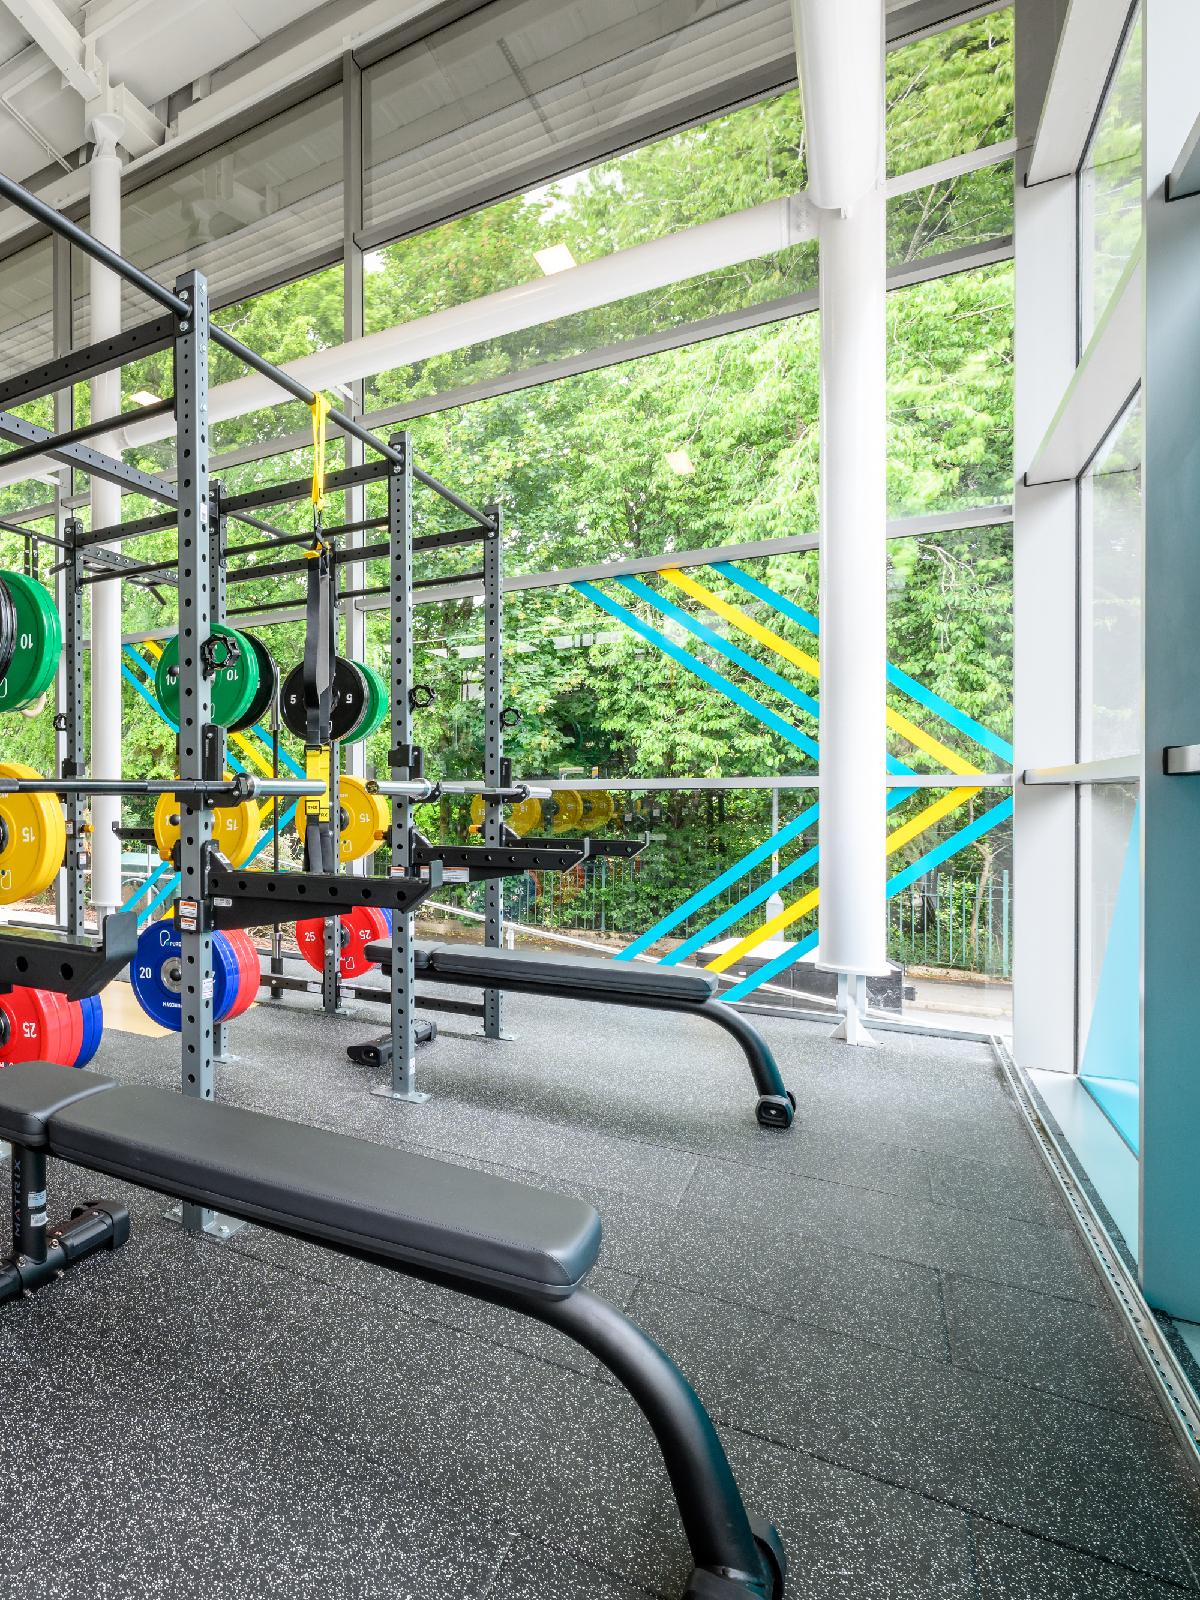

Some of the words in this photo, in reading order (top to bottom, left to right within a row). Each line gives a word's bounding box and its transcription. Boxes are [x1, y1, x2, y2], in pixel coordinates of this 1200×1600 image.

[20, 633, 33, 650] 10
[226, 669, 239, 681] 10
[289, 694, 297, 705] 5
[345, 693, 353, 704] 5
[359, 812, 370, 823] 15
[226, 818, 239, 831] 15
[21, 827, 36, 843] 15
[304, 931, 316, 942] 25
[358, 929, 371, 940] 25
[139, 966, 152, 979] 20
[22, 1022, 37, 1038] 25
